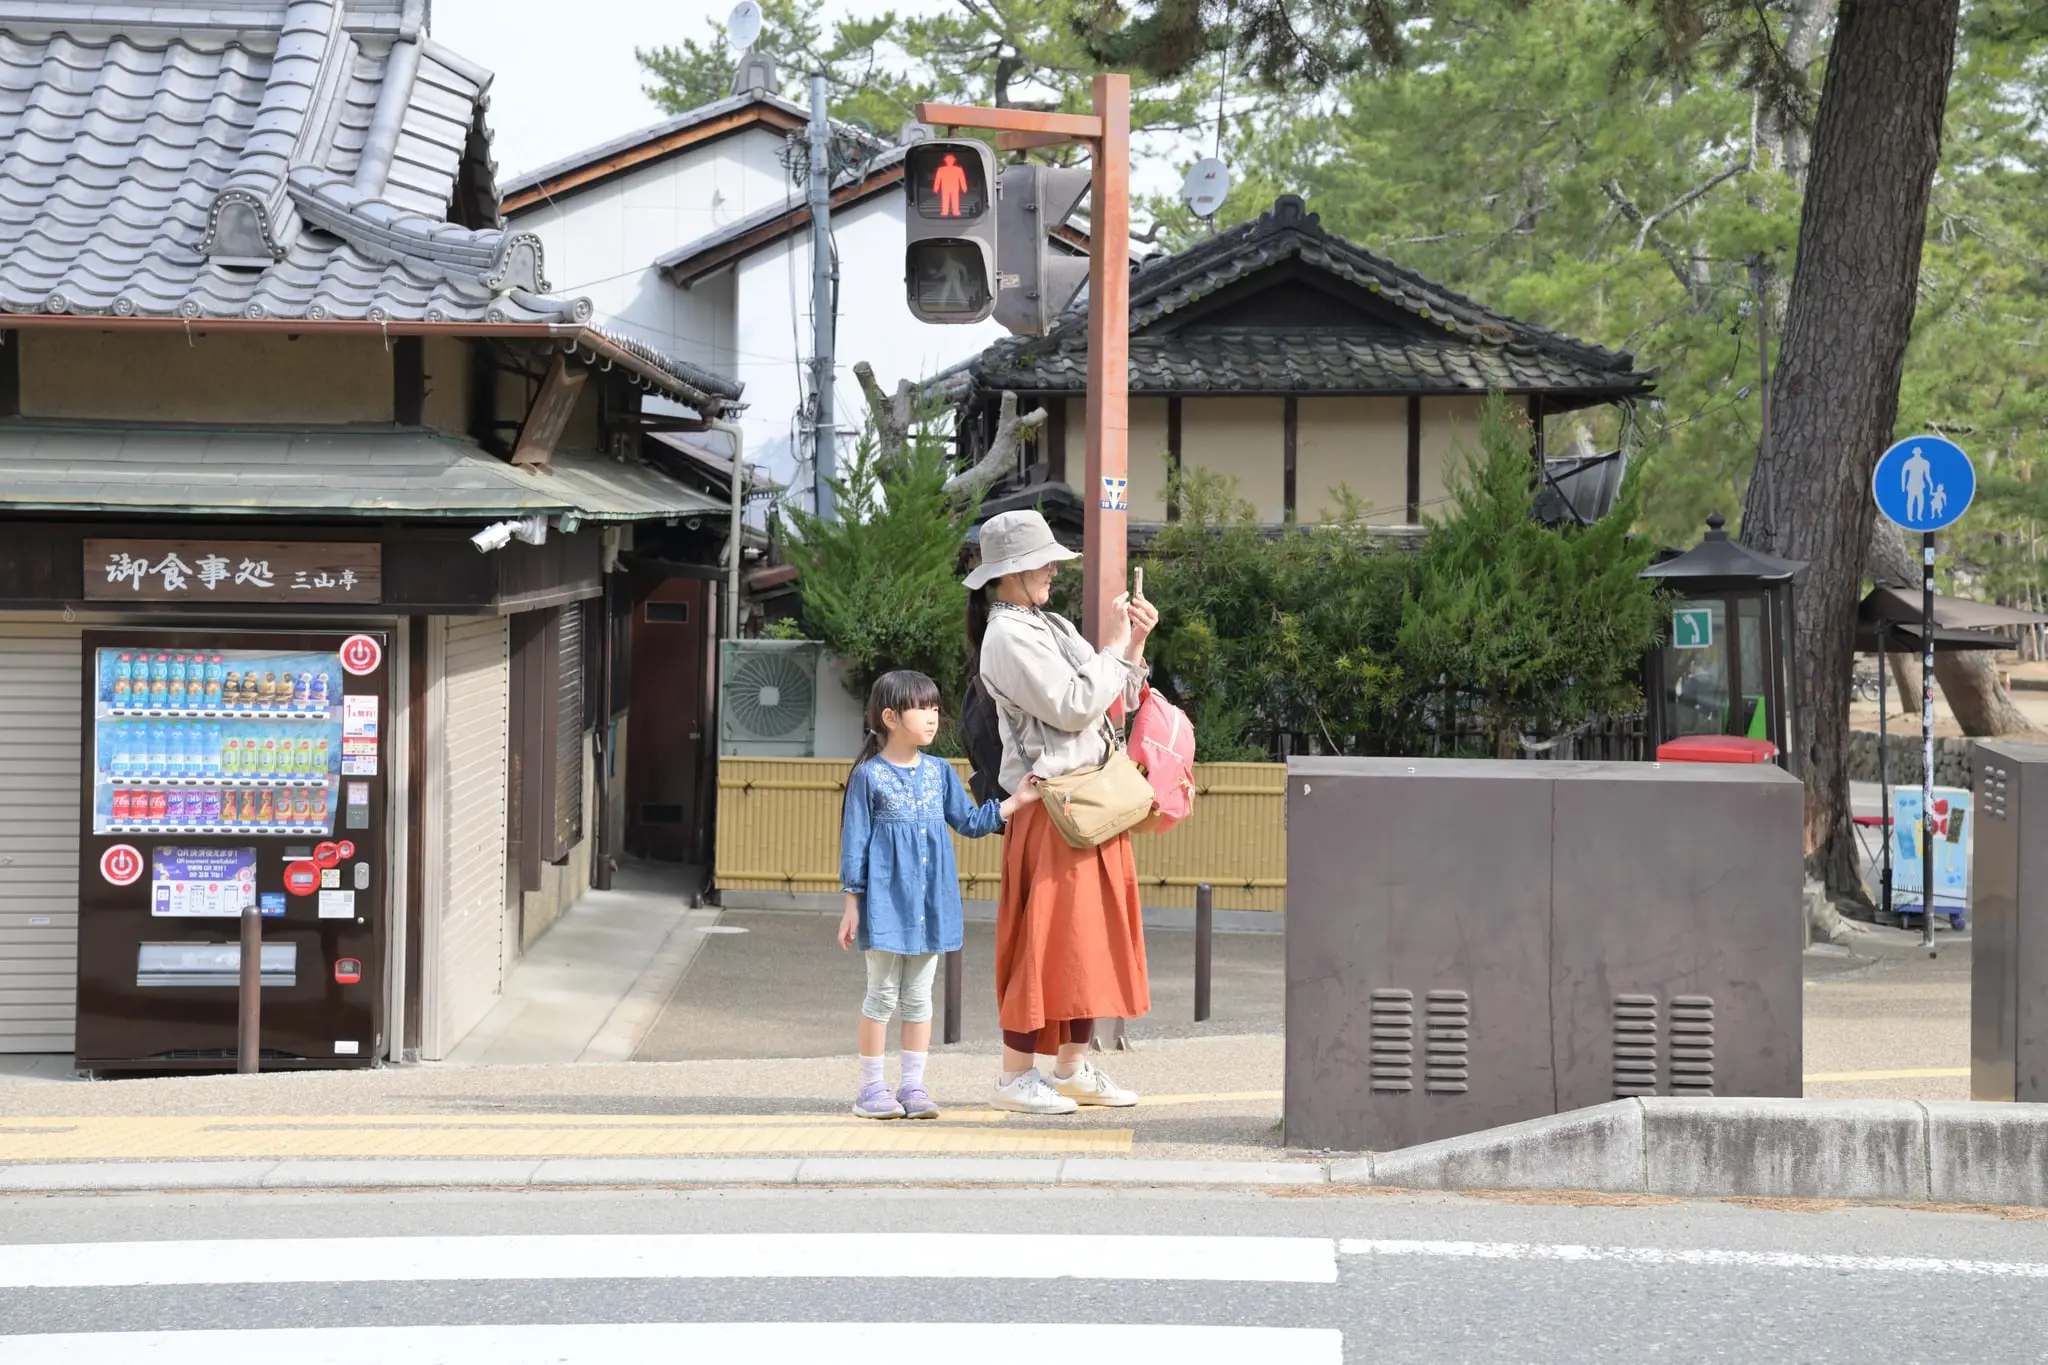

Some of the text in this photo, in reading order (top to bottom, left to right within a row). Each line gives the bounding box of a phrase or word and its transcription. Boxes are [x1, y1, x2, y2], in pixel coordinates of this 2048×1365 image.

[105, 552, 358, 591] 御食事処 三山亭
